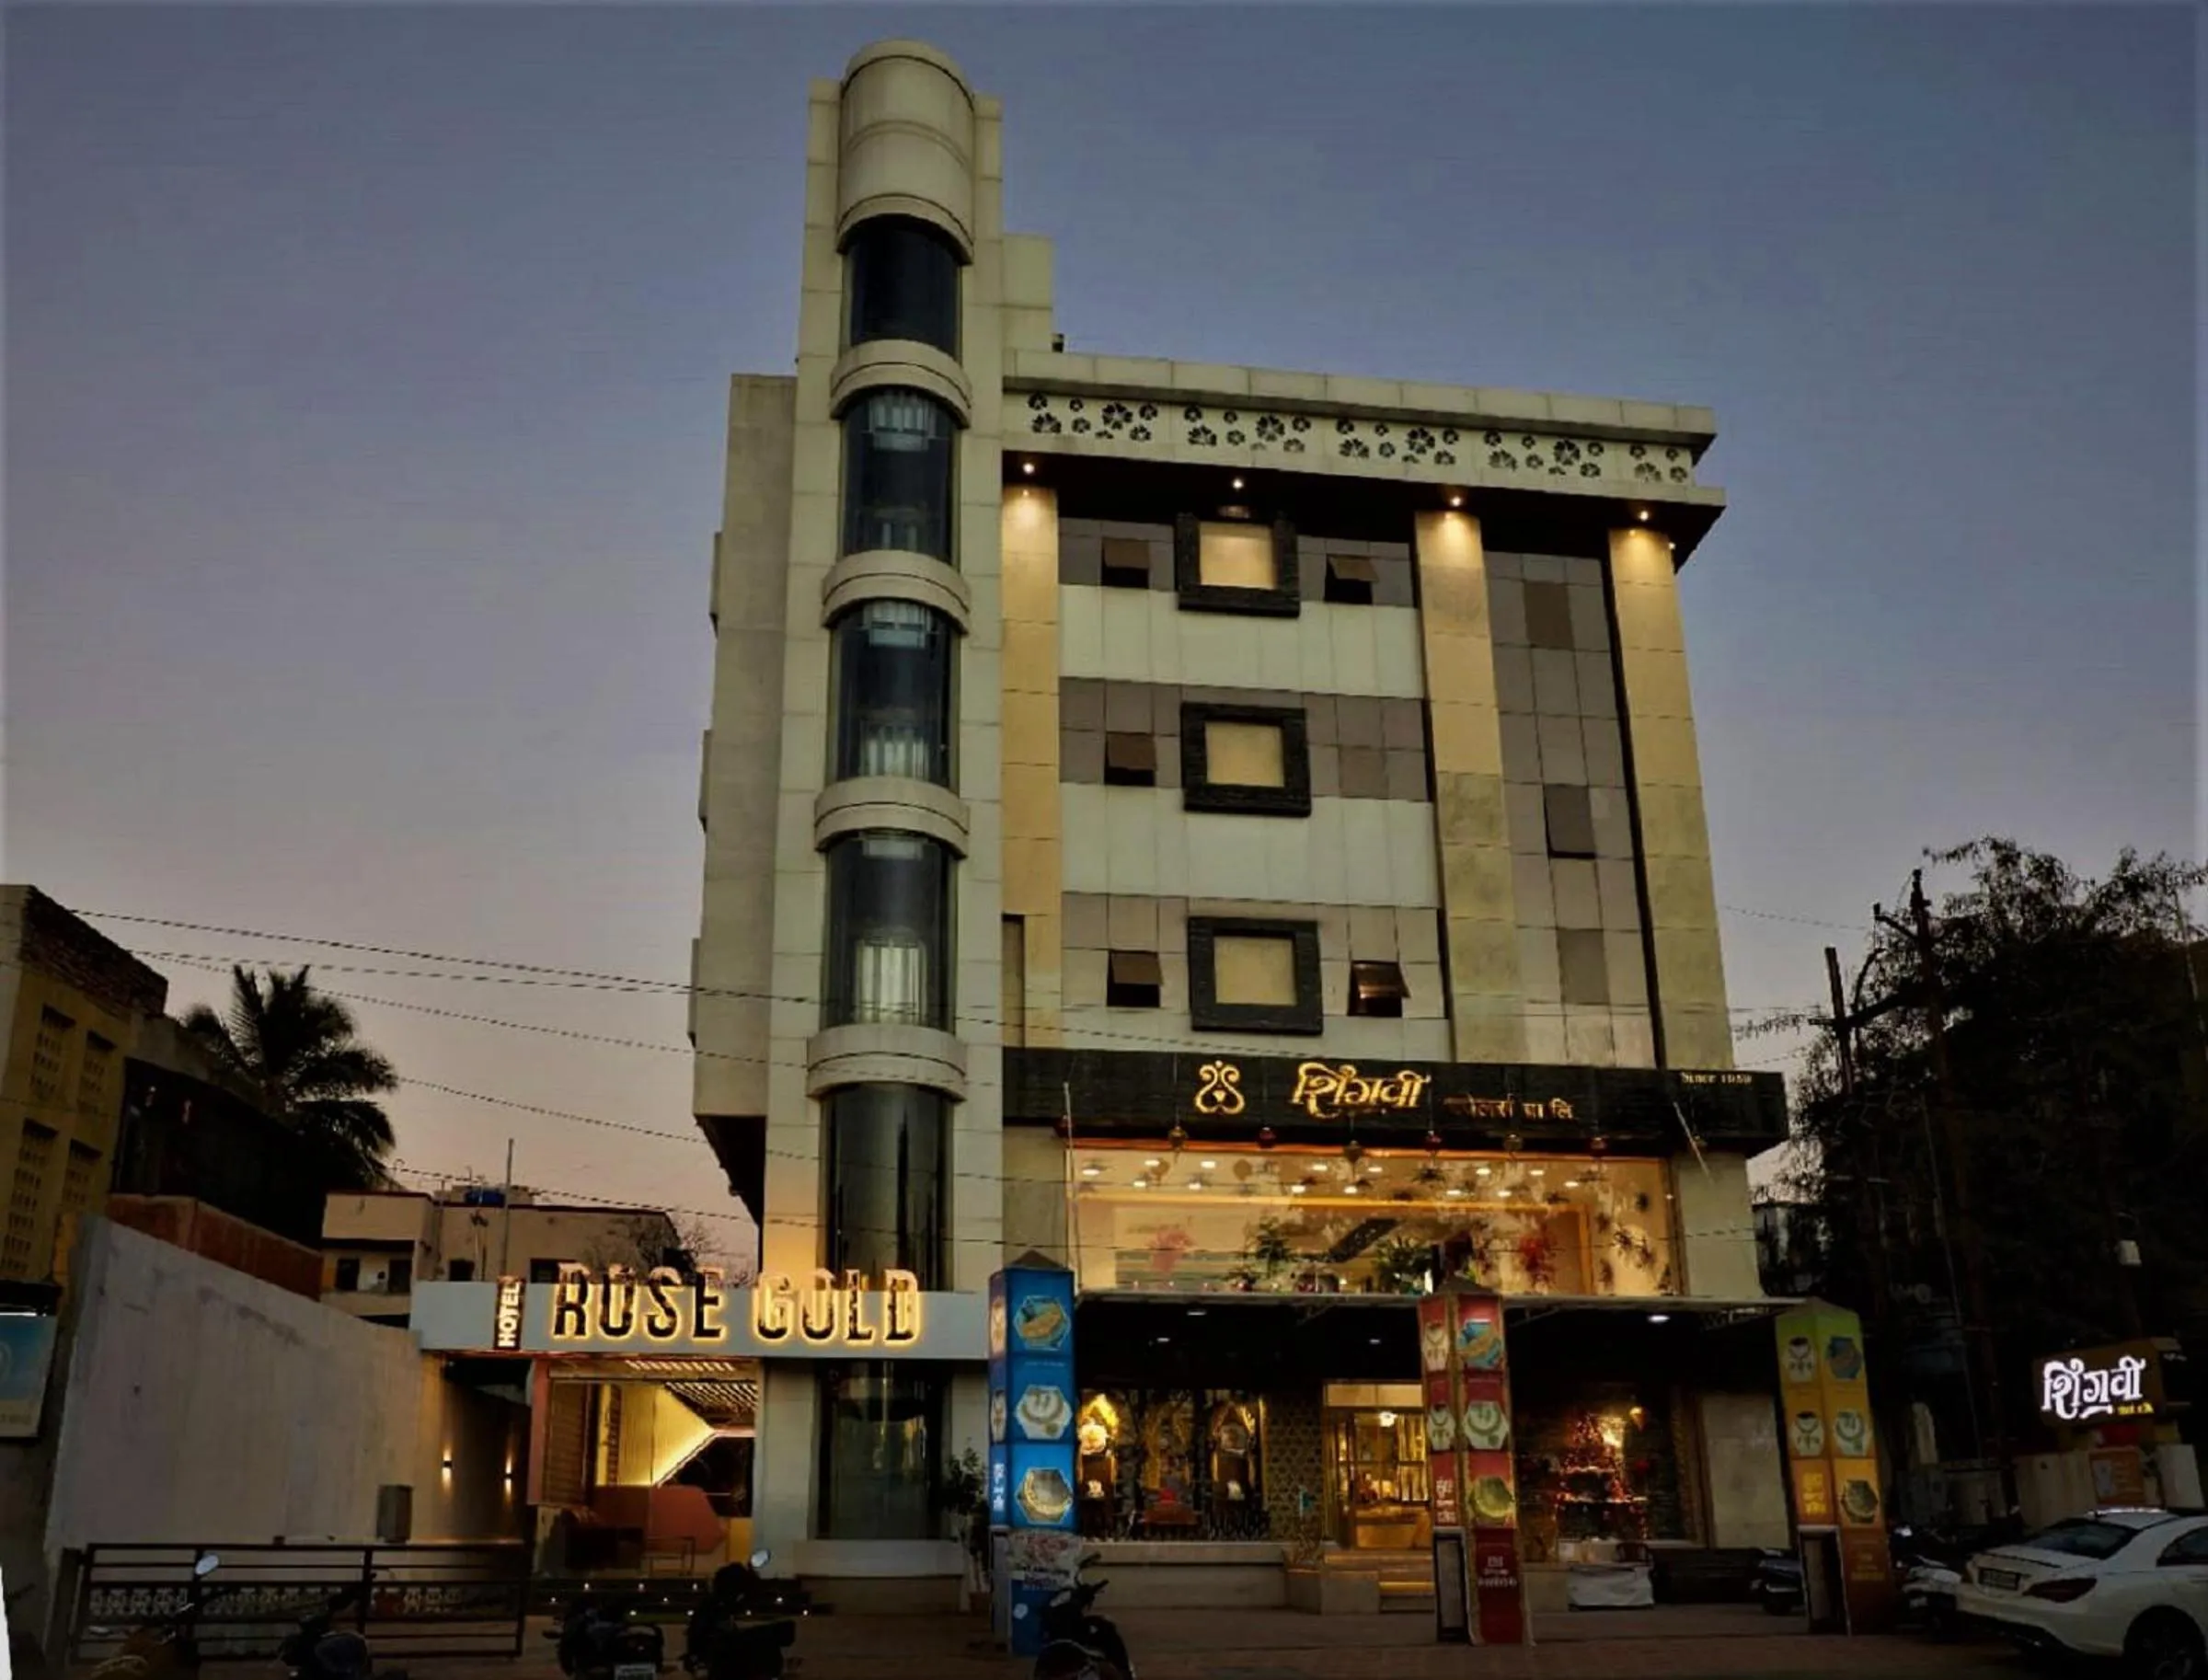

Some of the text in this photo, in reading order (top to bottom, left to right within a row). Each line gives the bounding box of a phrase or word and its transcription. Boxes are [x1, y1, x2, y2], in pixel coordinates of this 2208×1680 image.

[498, 1280, 521, 1348] HOTEL
[551, 1261, 922, 1347] ROSE GOLD
